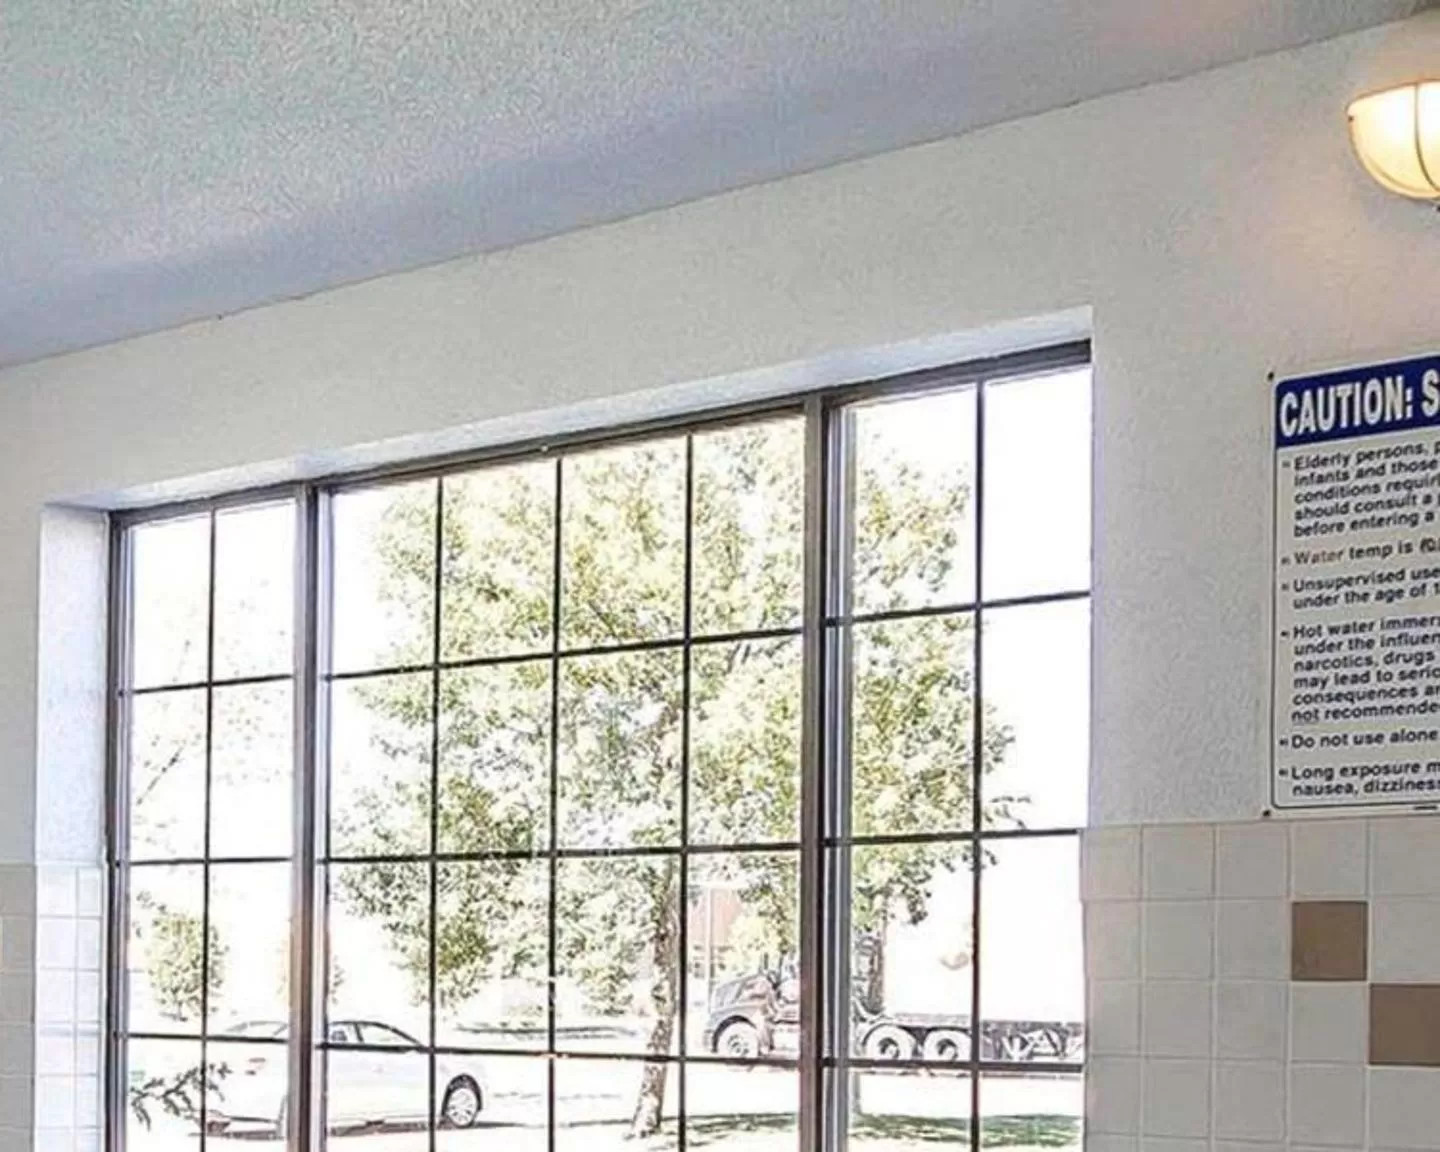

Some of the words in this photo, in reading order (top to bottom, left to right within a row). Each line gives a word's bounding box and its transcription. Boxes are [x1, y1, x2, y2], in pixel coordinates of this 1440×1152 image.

[1280, 375, 1412, 437] CAUTION:
[1294, 470, 1350, 486] infants
[1356, 463, 1386, 479] and
[1391, 458, 1438, 474] those
[1295, 453, 1350, 470] Elderly
[1294, 483, 1381, 504] conditions
[1294, 501, 1350, 520] should
[1354, 494, 1417, 513] consult
[1422, 493, 1433, 505] a
[1294, 520, 1345, 537] before
[1350, 512, 1420, 530] entering
[1424, 511, 1435, 523] a
[1294, 549, 1344, 565] Water
[1348, 544, 1393, 559] temp
[1398, 539, 1413, 554] is
[1293, 568, 1405, 593] Unsupervised
[1293, 593, 1340, 610] under
[1344, 590, 1370, 604] the
[1374, 588, 1405, 604] age
[1409, 583, 1427, 598] of
[1293, 624, 1323, 638] Hot
[1328, 620, 1375, 636] water
[1293, 638, 1344, 655] under
[1348, 636, 1375, 650] the
[1294, 654, 1379, 671] narcotics,
[1383, 650, 1435, 667] drugs
[1293, 674, 1329, 690] may
[1333, 670, 1371, 685] lead
[1376, 669, 1393, 682] to
[1293, 687, 1418, 705] consequences
[1292, 708, 1320, 723] not
[1292, 734, 1315, 748] Do
[1320, 731, 1348, 747] not
[1353, 732, 1385, 746] use
[1292, 765, 1334, 782] Long
[1339, 762, 1421, 780] exposure
[1292, 781, 1358, 797] nausea,
